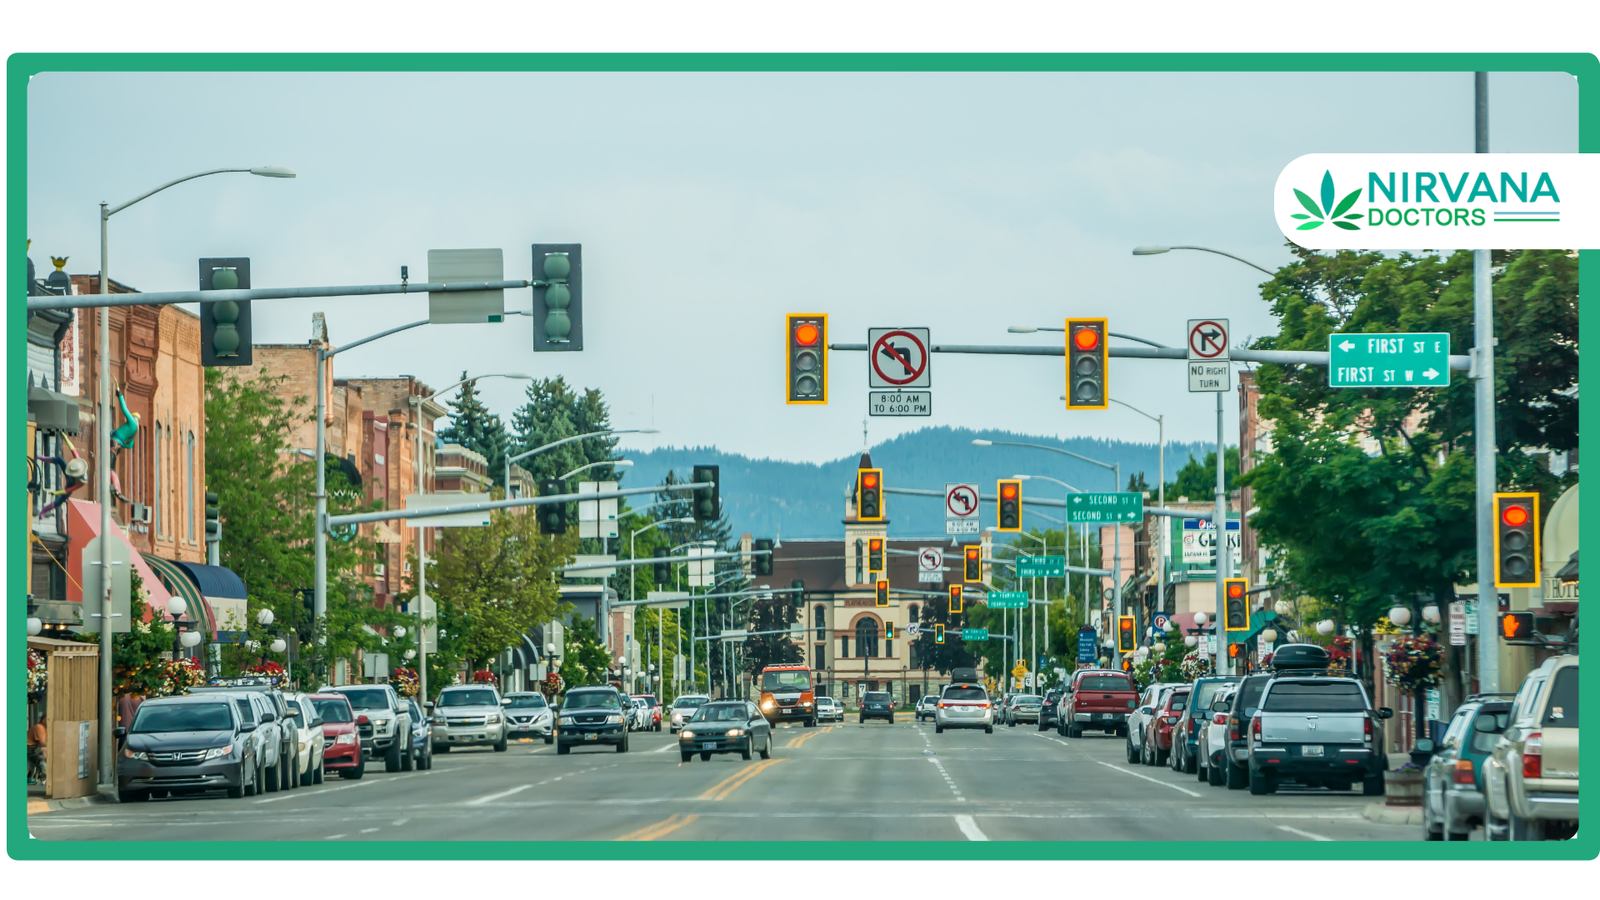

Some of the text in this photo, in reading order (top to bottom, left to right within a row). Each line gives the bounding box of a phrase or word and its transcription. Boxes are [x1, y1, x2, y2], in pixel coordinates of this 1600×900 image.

[1368, 338, 1441, 353] FIRST ST E
[1191, 365, 1227, 376] NO RIGHT
[1338, 366, 1414, 382] FIRST ST W
[1199, 379, 1220, 388] TURN
[881, 394, 920, 403] 8:00 AM
[874, 404, 927, 413] TO 6:00 PM
[1089, 494, 1118, 505] SECOND
[1122, 496, 1129, 505] ST
[1073, 510, 1101, 521] SECOND
[1106, 512, 1113, 520] ST
